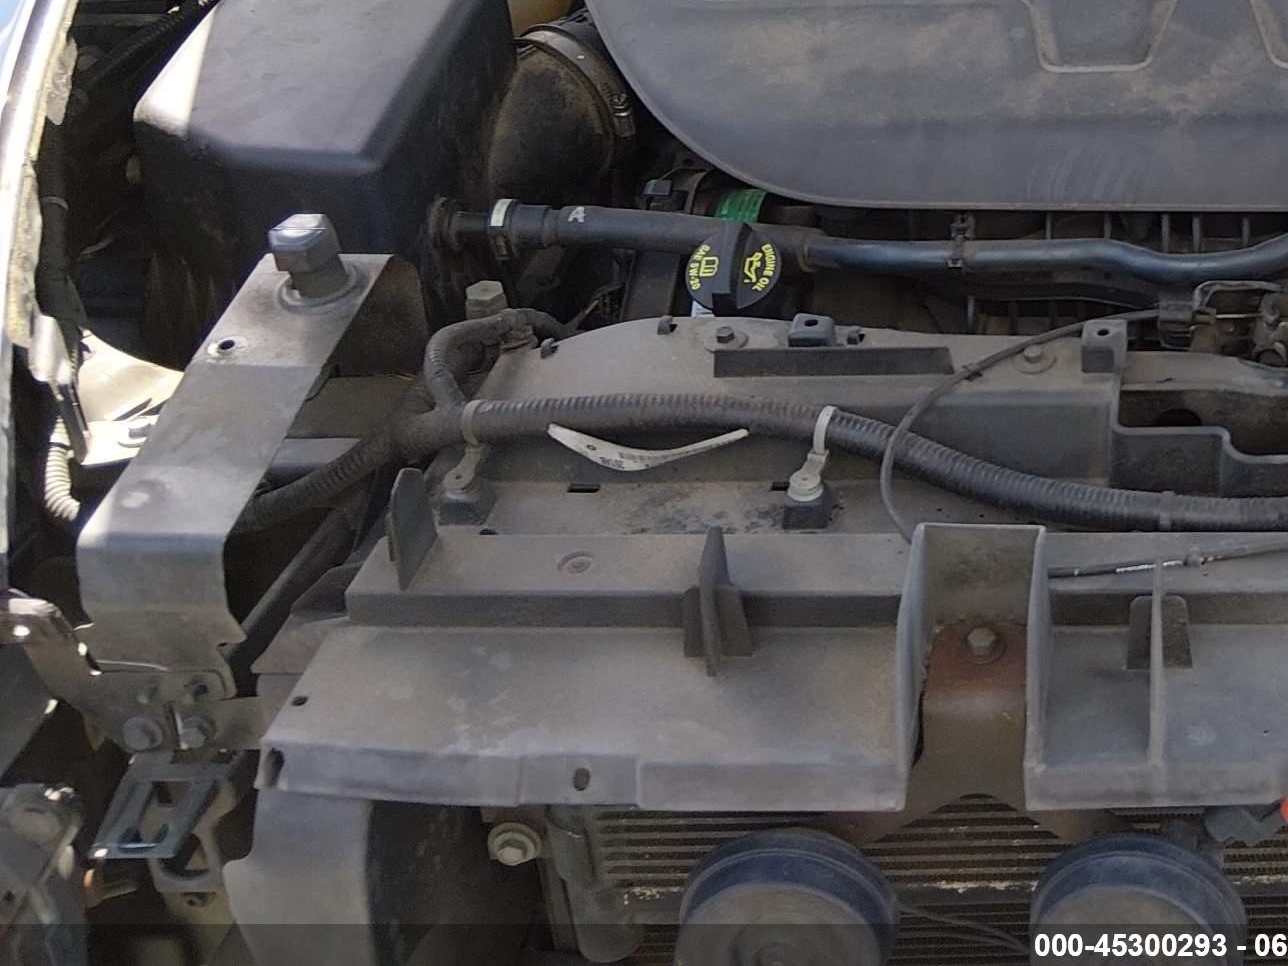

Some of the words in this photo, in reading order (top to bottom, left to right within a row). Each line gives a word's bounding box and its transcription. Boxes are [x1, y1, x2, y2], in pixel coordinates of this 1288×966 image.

[693, 243, 711, 261] SAE
[761, 243, 776, 276] ENGINE
[751, 277, 770, 292] OIL
